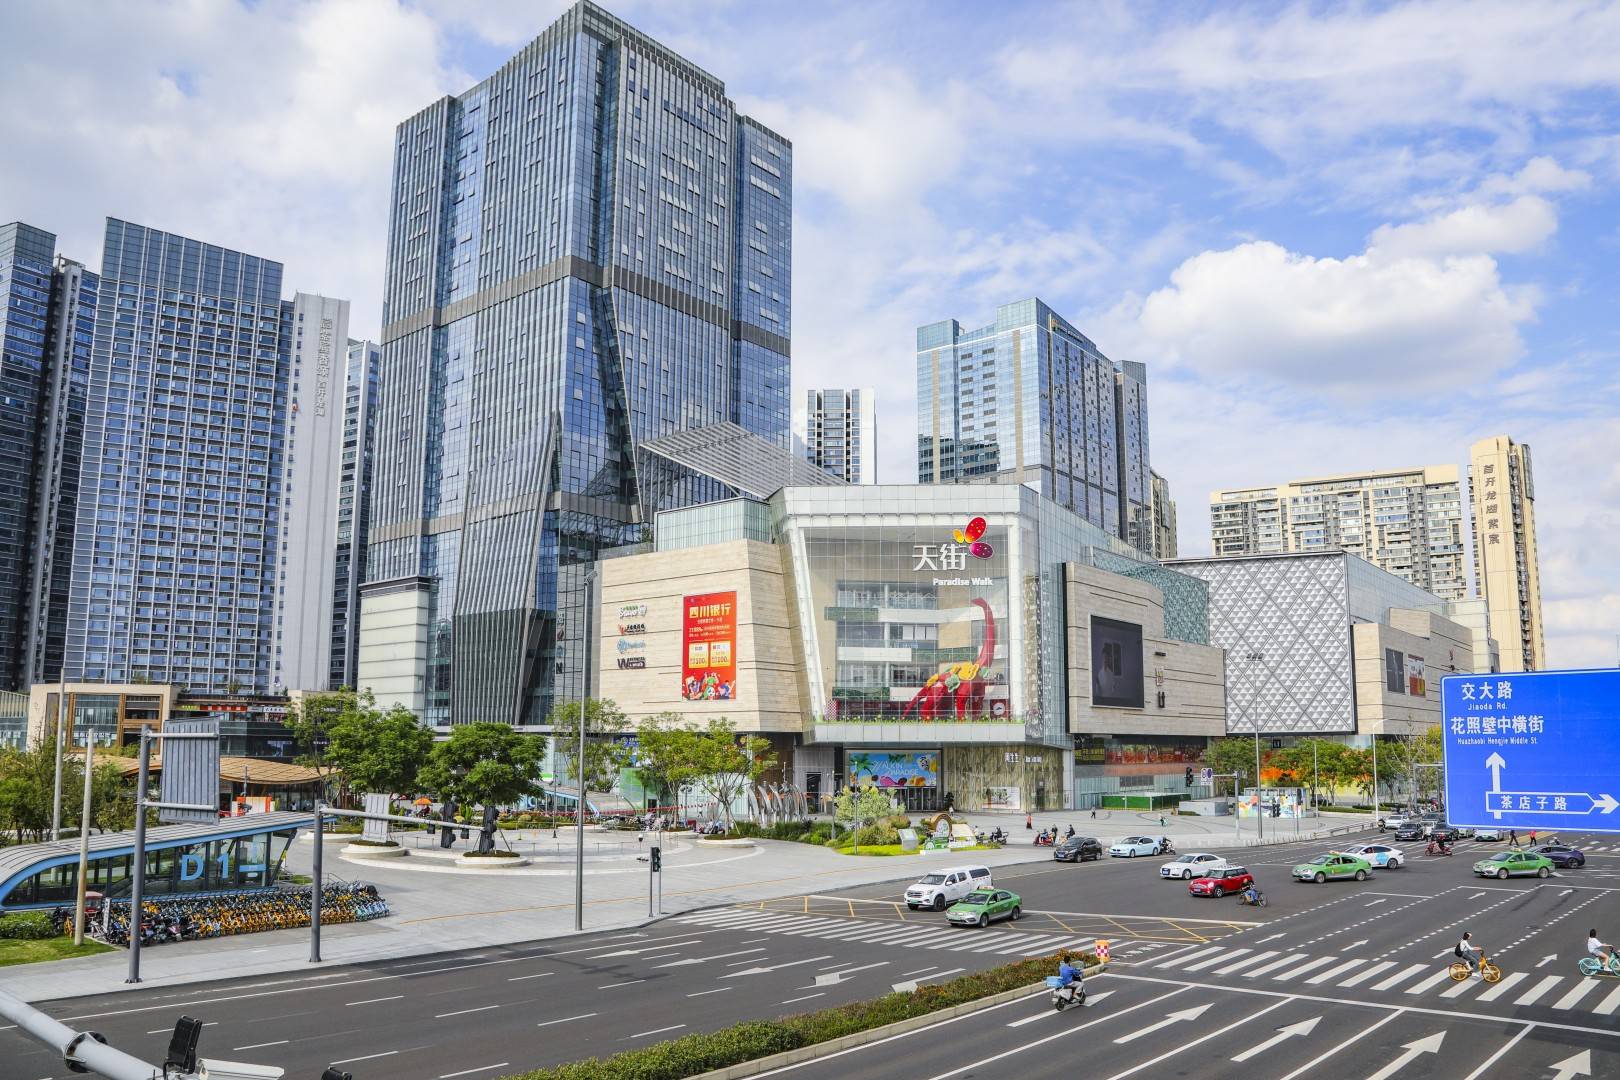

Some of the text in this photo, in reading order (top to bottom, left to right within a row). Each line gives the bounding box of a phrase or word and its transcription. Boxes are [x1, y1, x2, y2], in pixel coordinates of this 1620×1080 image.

[912, 543, 968, 571] 天街
[933, 577, 993, 586] Paradise Walk
[689, 603, 731, 618] 四川银行
[1461, 681, 1512, 700] 交大路
[1468, 702, 1508, 711] Jiaoda Rd.
[1451, 715, 1544, 735] 花照壁中横街
[1457, 737, 1486, 745] Huazhaobi
[1487, 737, 1508, 746] Hengjie
[1510, 737, 1528, 745] Middle
[1501, 796, 1567, 811] 茶店子路
